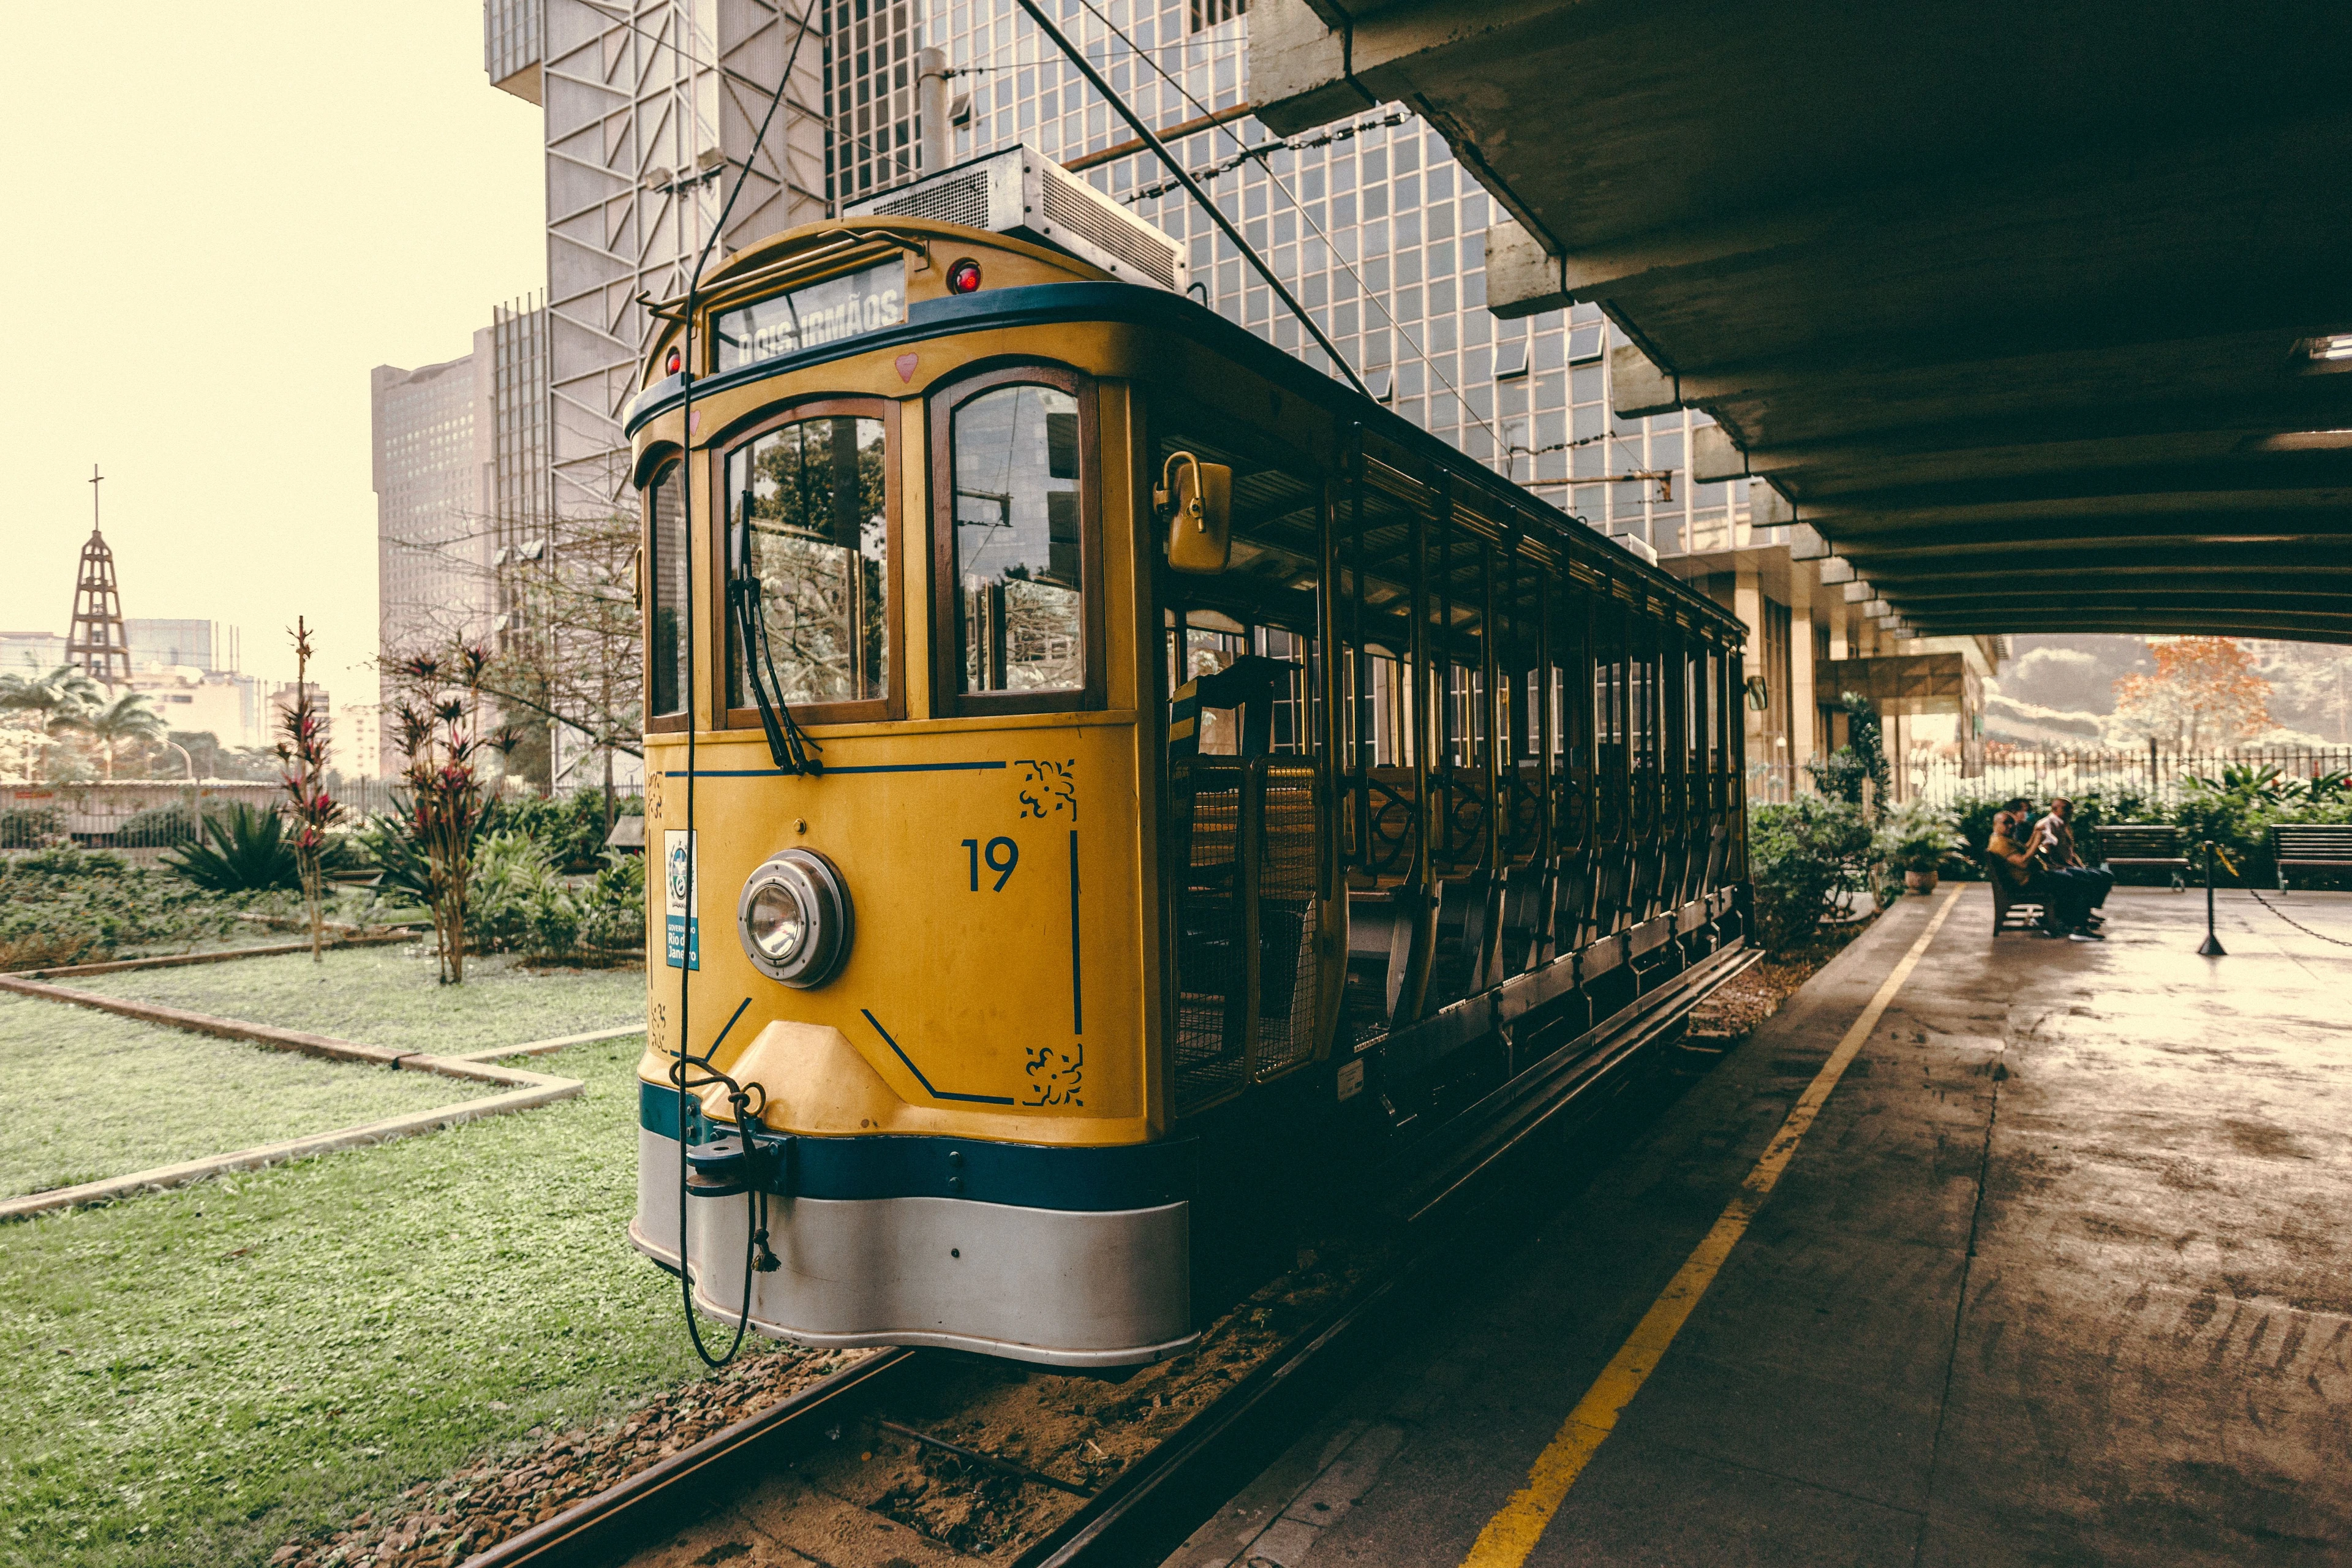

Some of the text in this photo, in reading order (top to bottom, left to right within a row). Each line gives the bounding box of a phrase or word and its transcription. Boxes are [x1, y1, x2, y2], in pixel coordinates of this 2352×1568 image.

[738, 289, 898, 367] DOIS IRMÃOS
[960, 835, 1019, 893] 19
[668, 924, 685, 932] GOVERN
[668, 932, 685, 946] Rio d
[668, 945, 696, 962] Janeo
